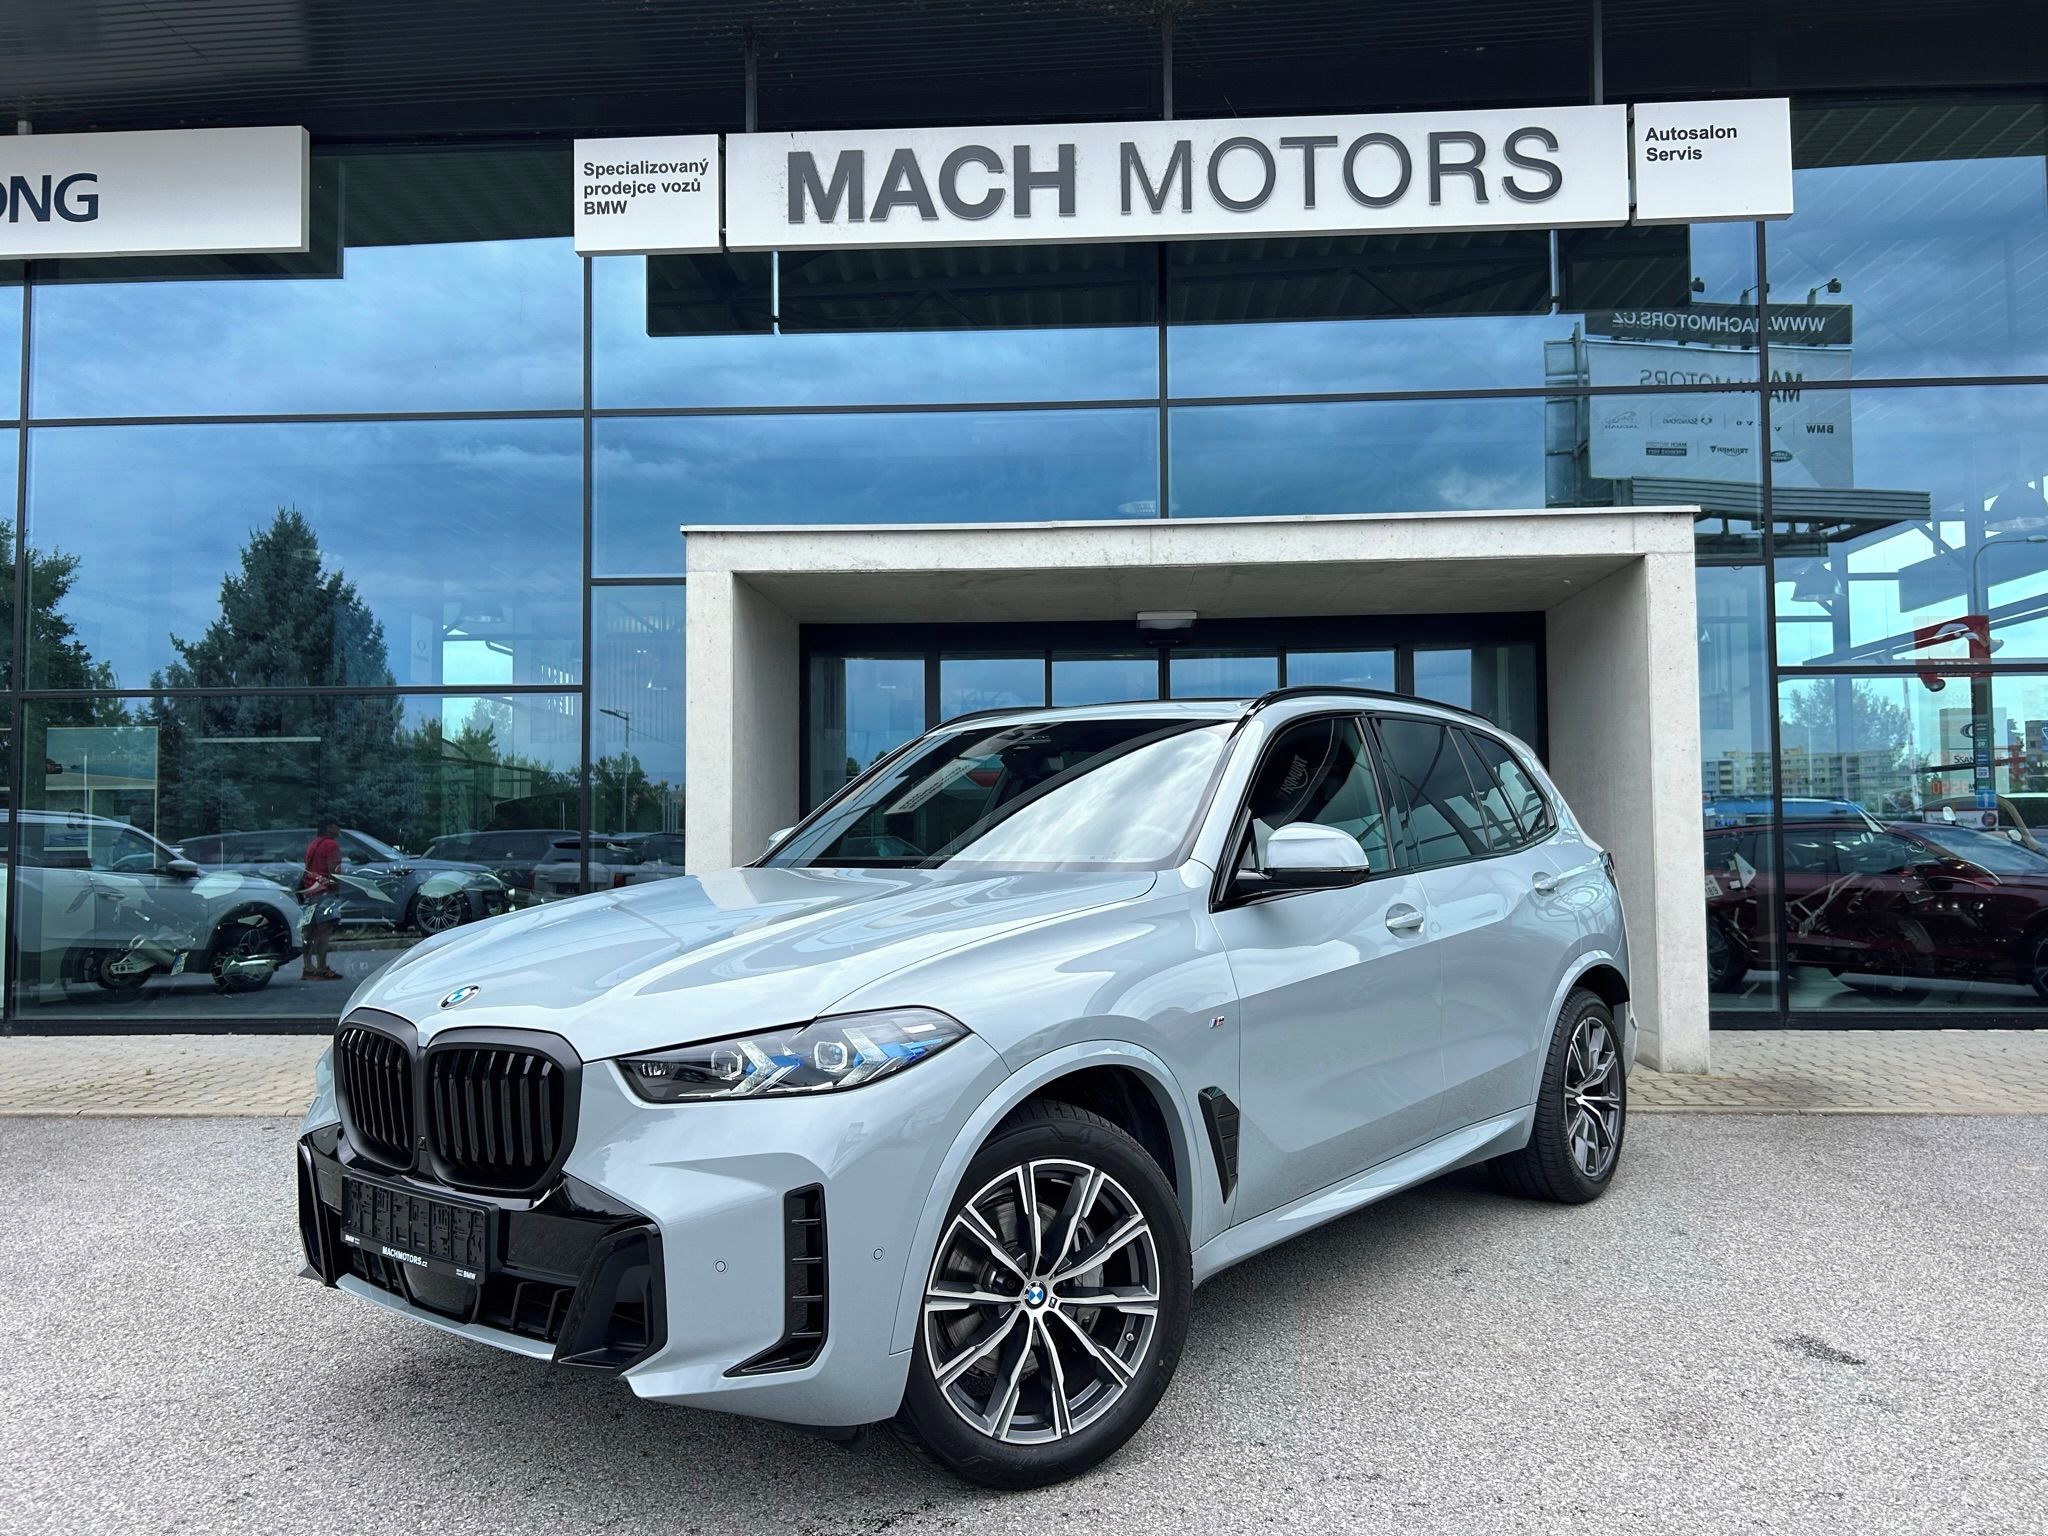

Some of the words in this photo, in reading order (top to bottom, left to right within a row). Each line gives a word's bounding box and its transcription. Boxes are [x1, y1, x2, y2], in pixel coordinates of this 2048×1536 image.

[1645, 124, 1738, 142] Autosalon
[1646, 146, 1703, 162] Servis
[583, 158, 709, 179] Specializovaný
[787, 143, 1077, 224] MACH
[1120, 126, 1564, 214] MOTORS
[0, 173, 99, 223] NG
[584, 180, 656, 199] prodejce
[661, 178, 701, 193] vozů
[584, 200, 628, 215] BMW
[382, 1246, 428, 1268] MACHMOTORS.cz
